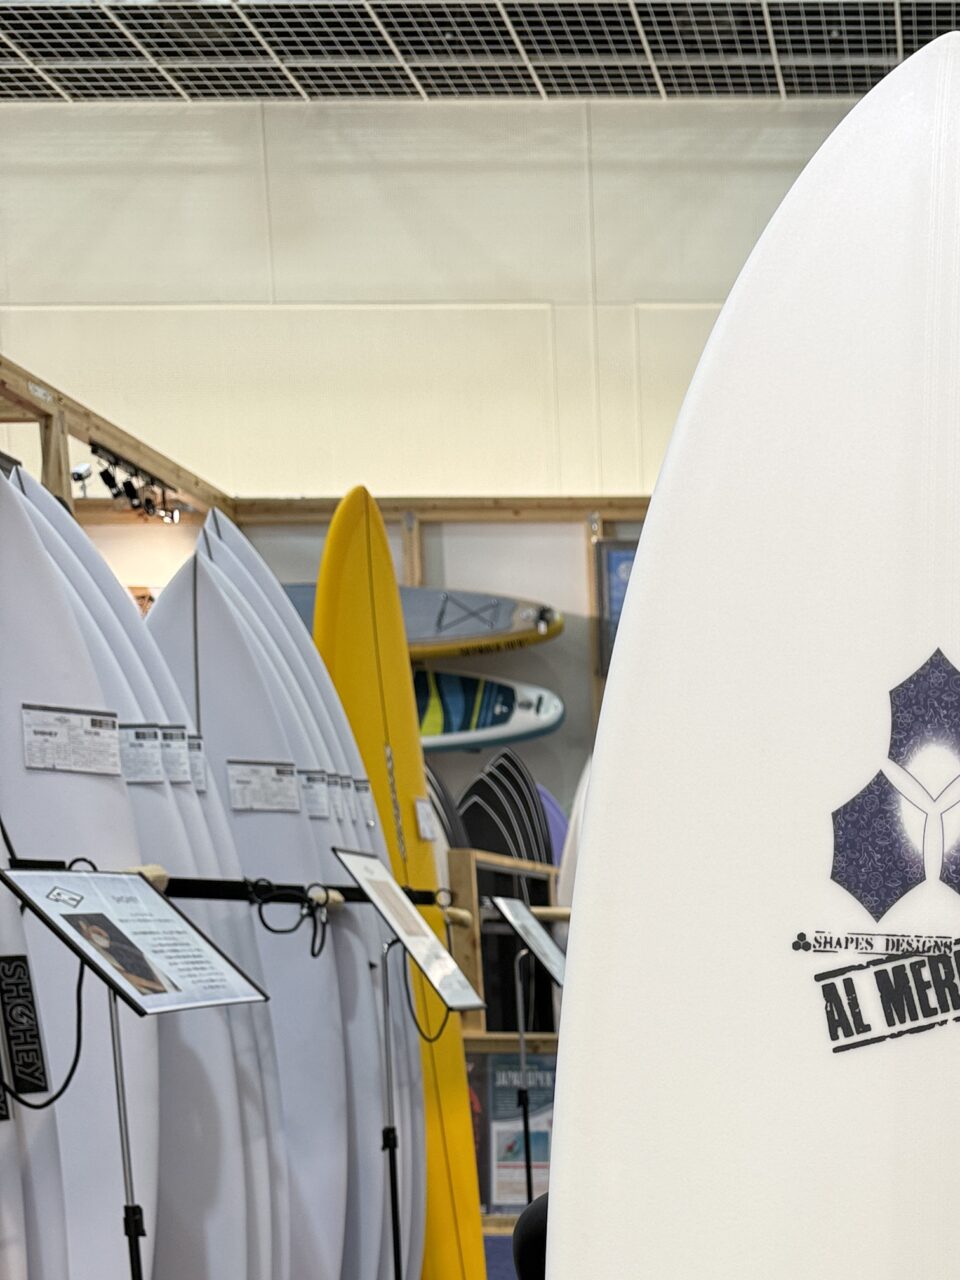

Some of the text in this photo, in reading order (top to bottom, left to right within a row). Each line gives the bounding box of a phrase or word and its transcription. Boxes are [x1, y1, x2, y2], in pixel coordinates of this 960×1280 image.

[813, 936, 953, 954] SHAPES DESIGNS
[821, 977, 871, 1041] AL
